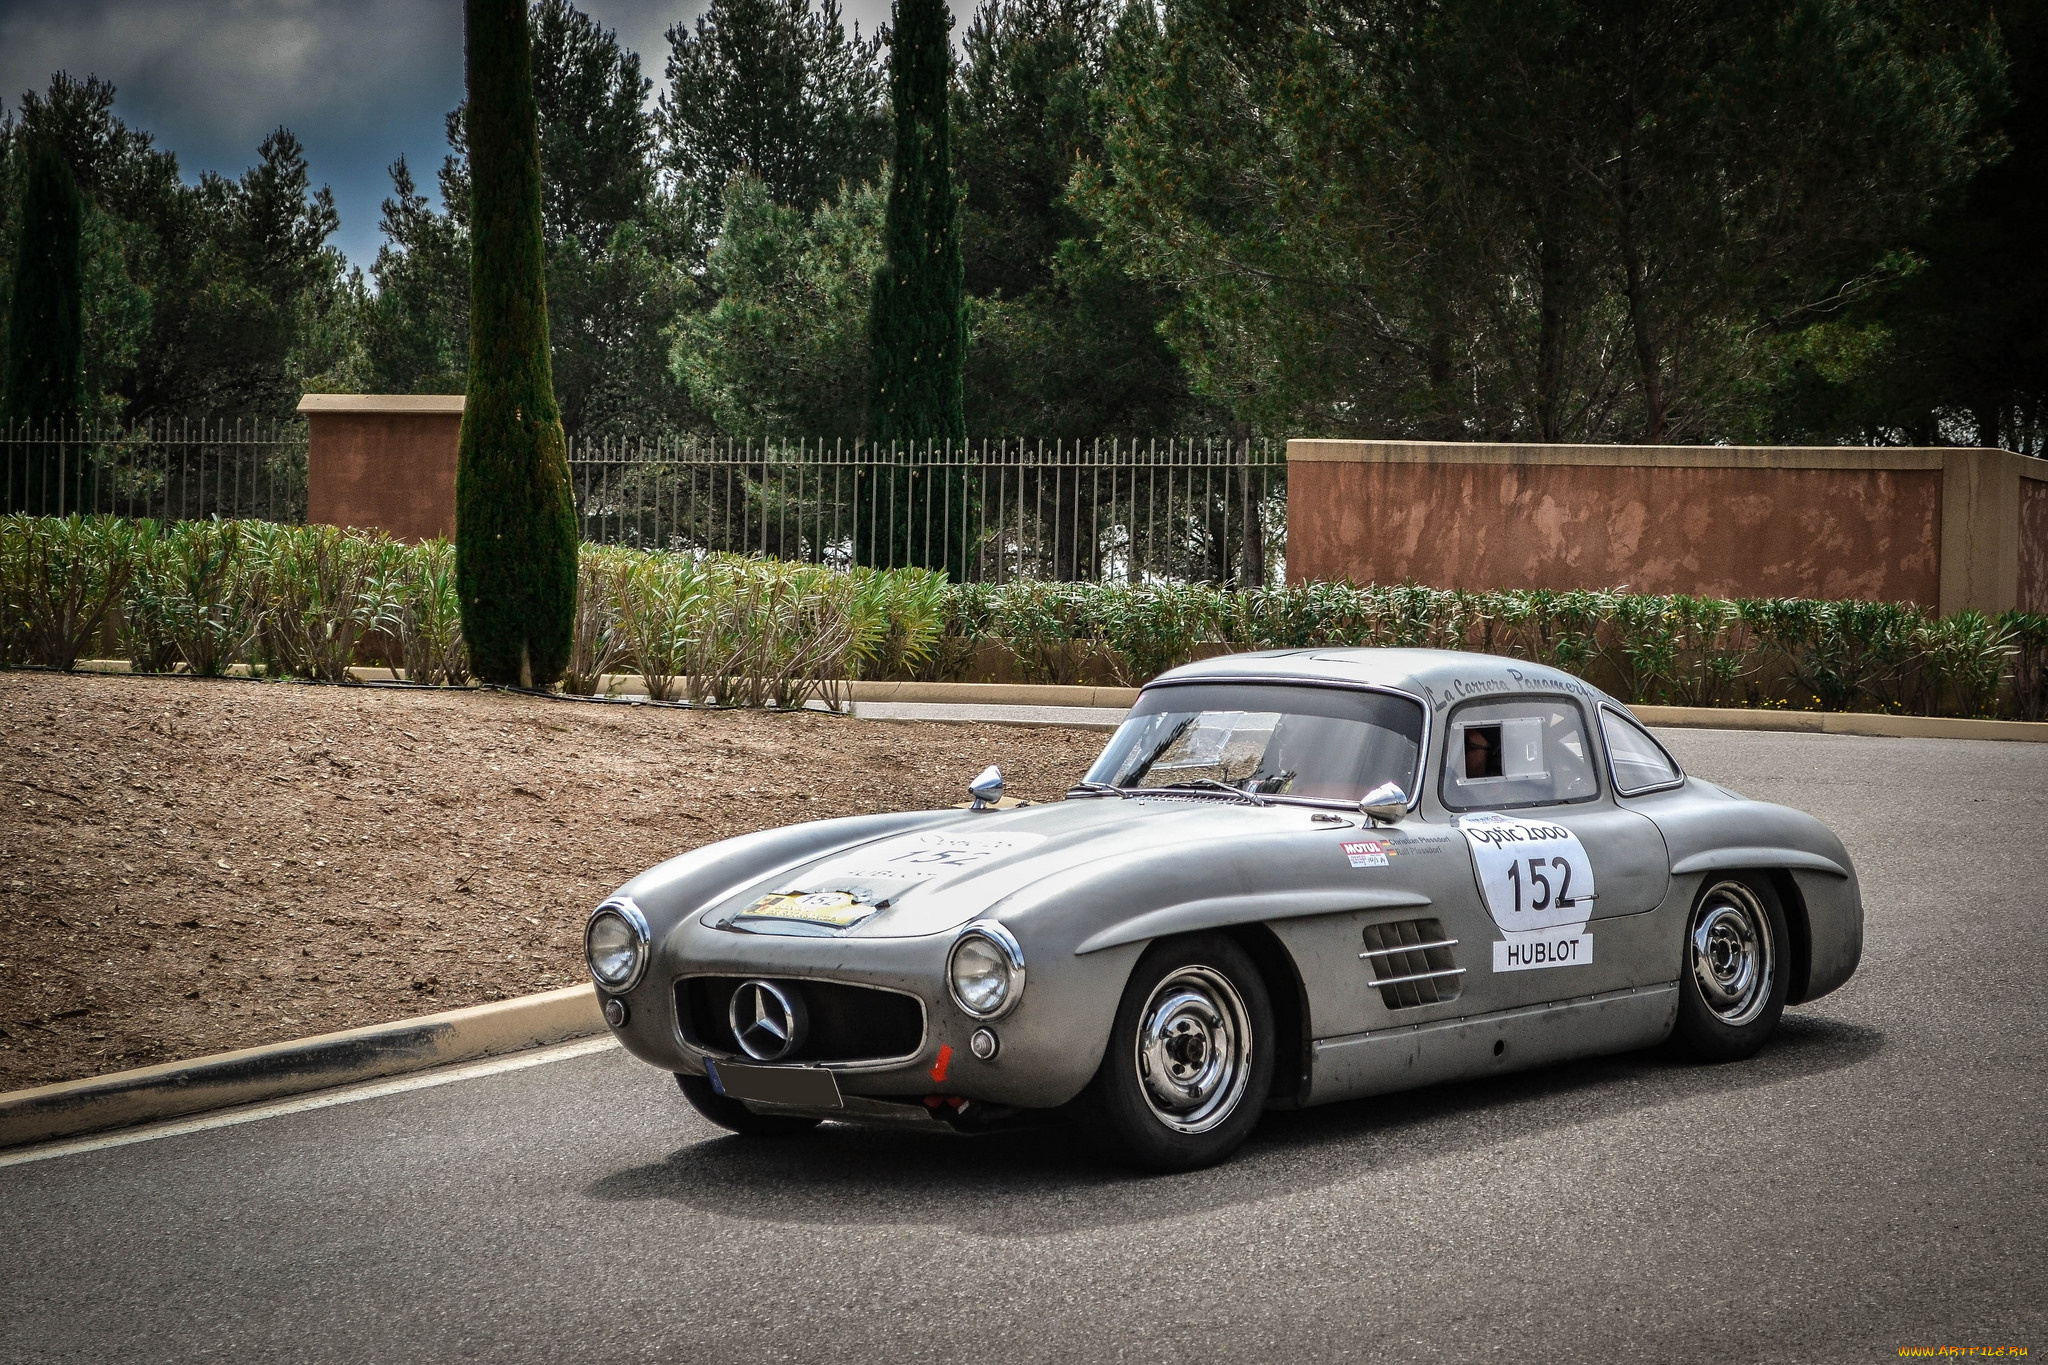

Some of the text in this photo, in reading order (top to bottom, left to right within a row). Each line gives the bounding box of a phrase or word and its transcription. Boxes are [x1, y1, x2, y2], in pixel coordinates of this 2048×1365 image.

[1425, 686, 1454, 712] La
[1453, 678, 1511, 698] Carrera
[1343, 842, 1381, 854] MOTUL
[1467, 824, 1569, 850] Optic 2000
[1507, 856, 1576, 913] 152
[1507, 939, 1580, 966] HUBLOT
